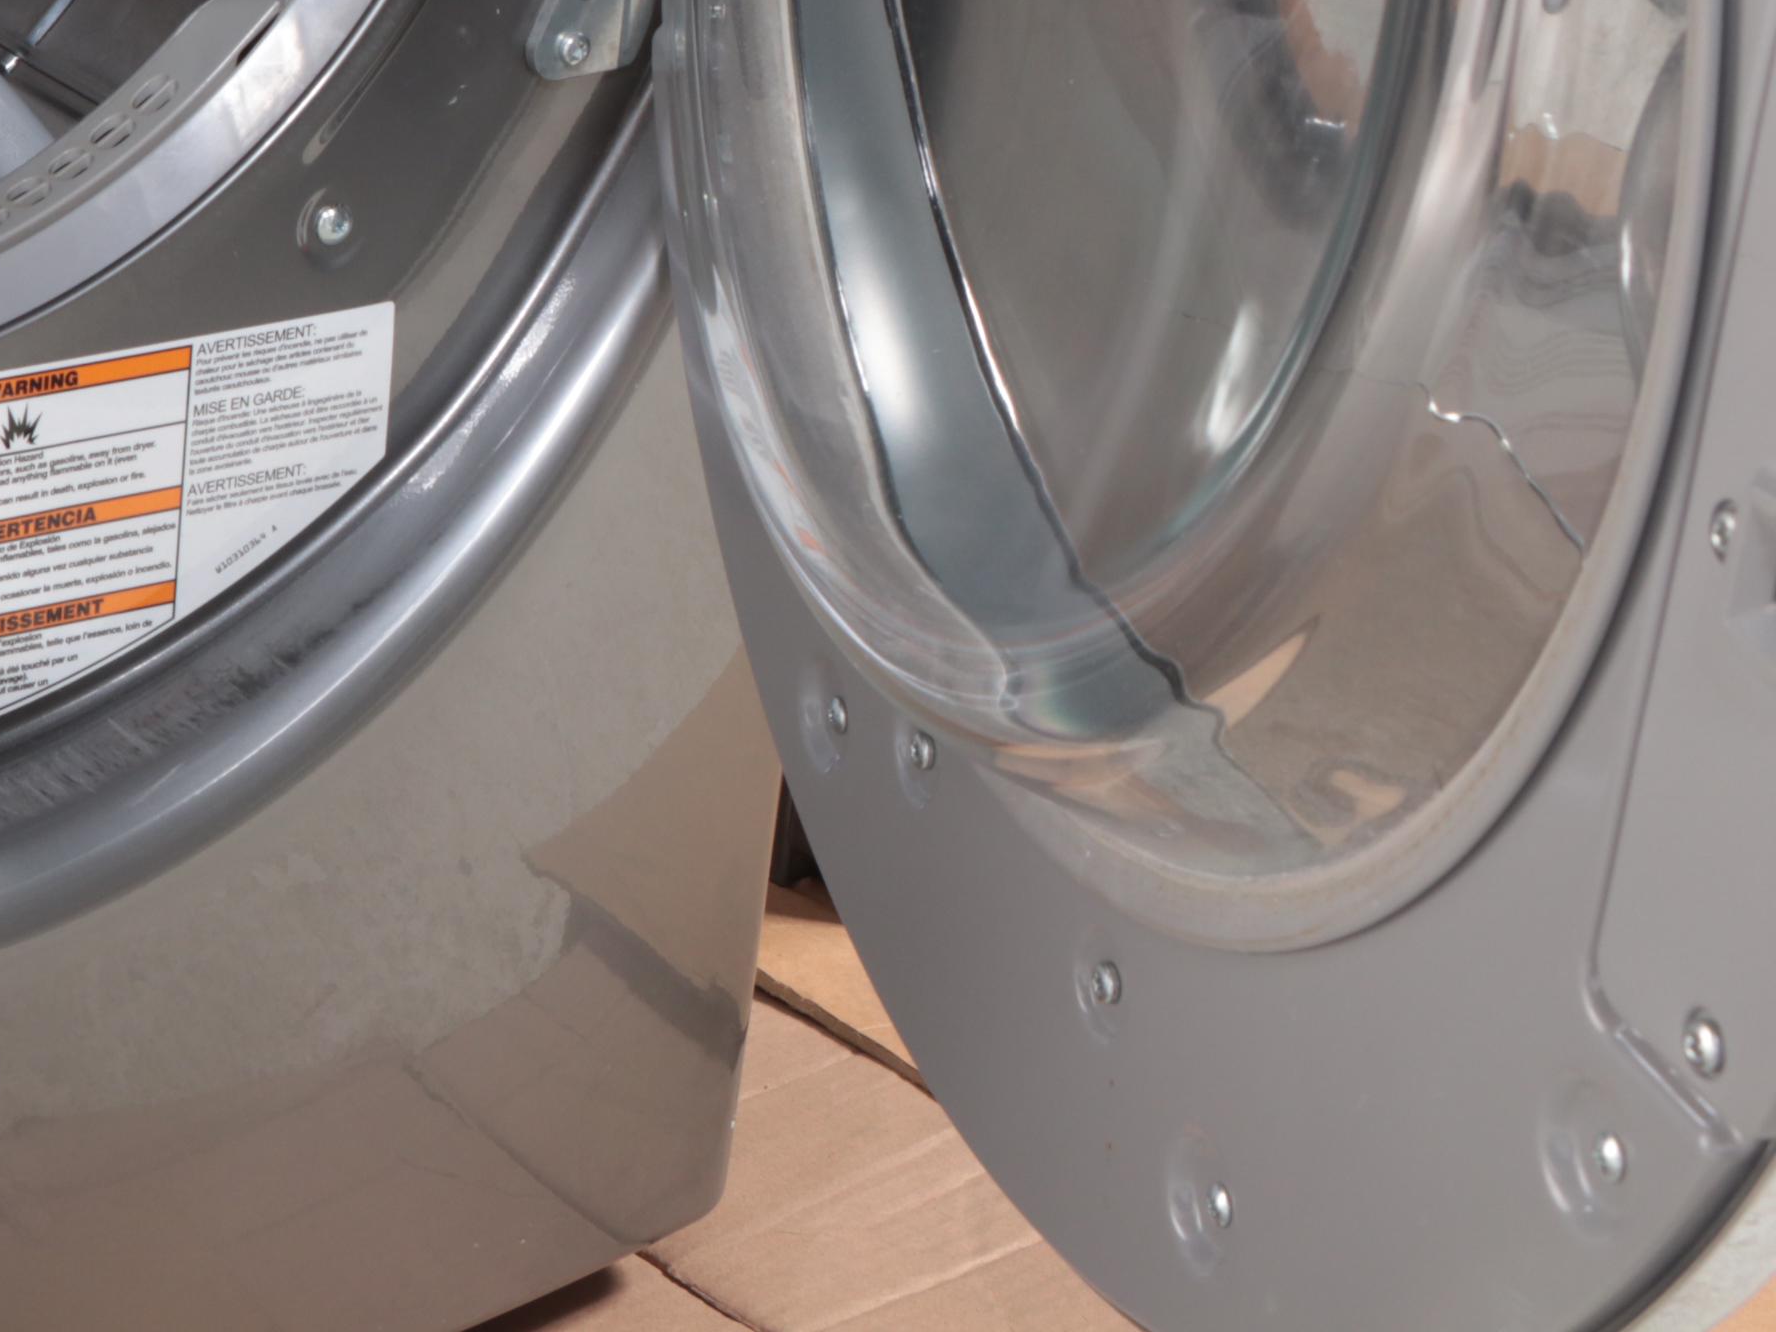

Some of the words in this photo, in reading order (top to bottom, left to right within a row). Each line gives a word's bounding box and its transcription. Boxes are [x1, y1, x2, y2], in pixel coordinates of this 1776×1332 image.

[197, 323, 316, 356] AVERTISSEMENT:
[192, 398, 227, 417] MISE
[229, 394, 249, 411] EN
[252, 385, 304, 406] GARDE:
[11, 470, 47, 482] anything
[49, 461, 92, 475] flammable
[106, 457, 112, 465] it
[113, 454, 136, 465] (even
[13, 450, 43, 463] Hazard
[14, 461, 35, 472] such
[37, 460, 47, 468] as
[48, 454, 86, 467] gasoline,
[88, 449, 109, 458] away
[111, 445, 130, 454] from
[132, 441, 155, 450] dryer.
[15, 490, 38, 501] result
[49, 483, 75, 495] death,
[77, 477, 117, 490] explosion
[130, 472, 145, 480] fire.
[187, 462, 306, 497] AVERTISSEMENT:
